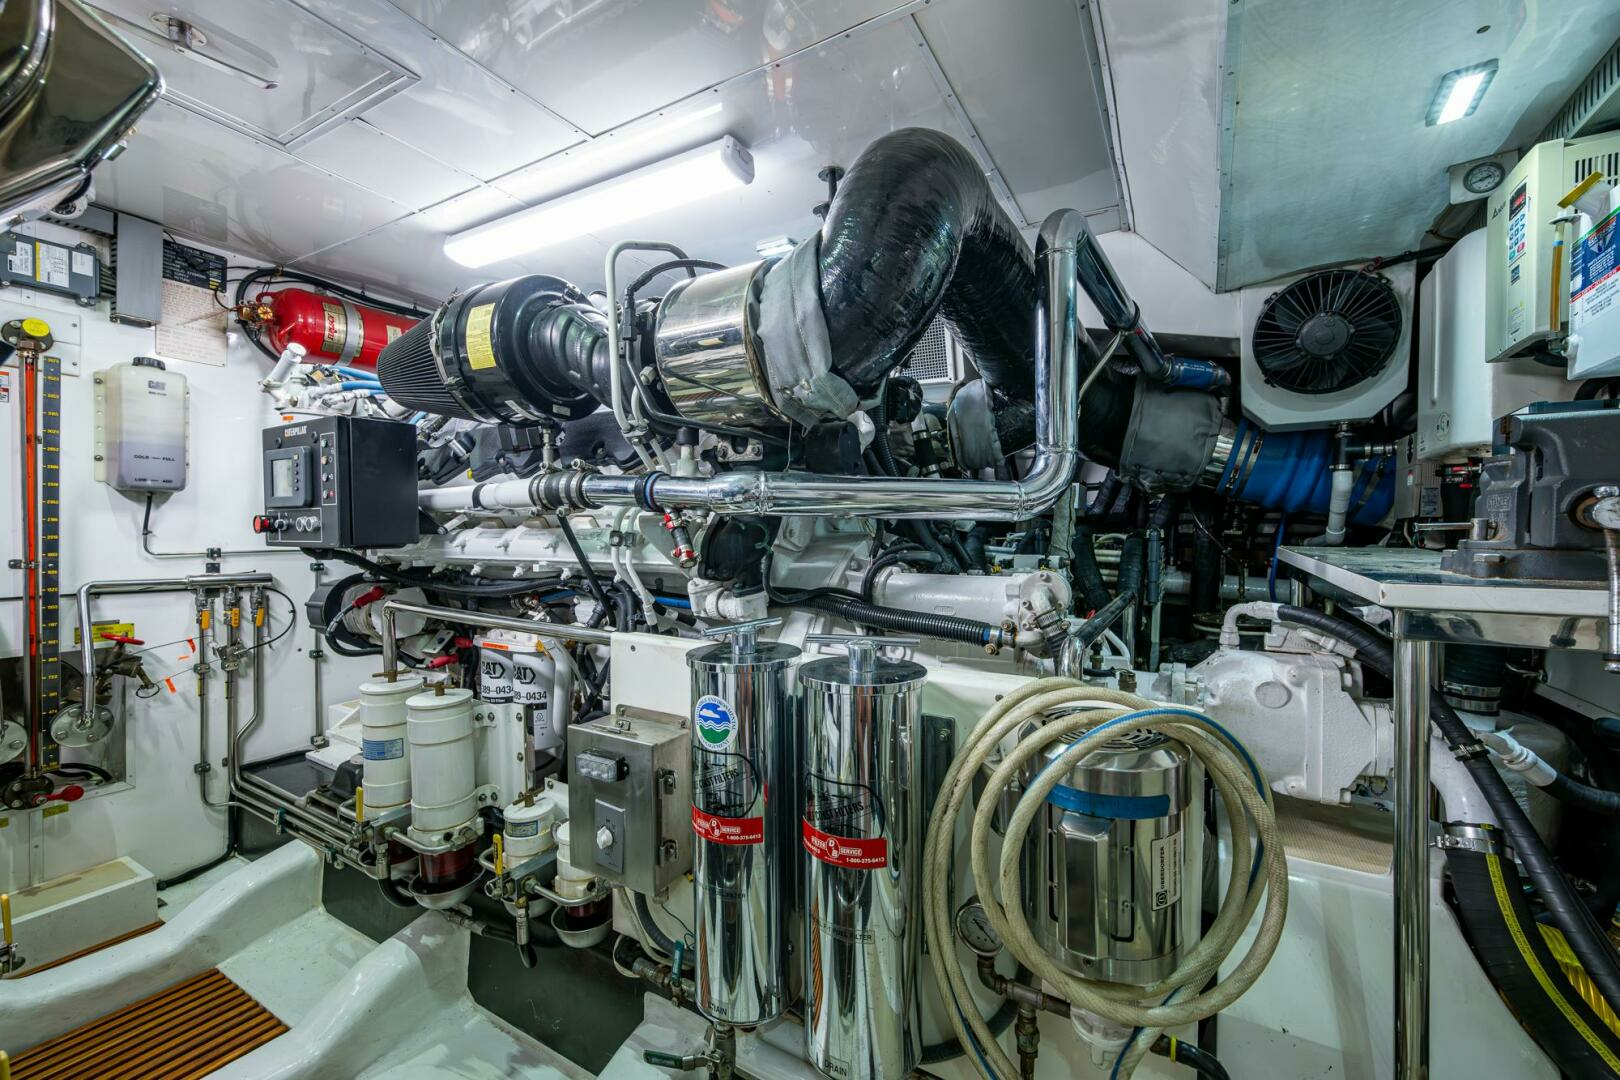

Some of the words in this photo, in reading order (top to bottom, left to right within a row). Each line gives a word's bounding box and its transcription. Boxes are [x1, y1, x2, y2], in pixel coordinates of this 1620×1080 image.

[713, 768, 740, 785] FILTERS
[833, 800, 865, 818] FILTERS
[840, 847, 862, 856] SERVICE
[824, 1059, 847, 1077] DRAIN
